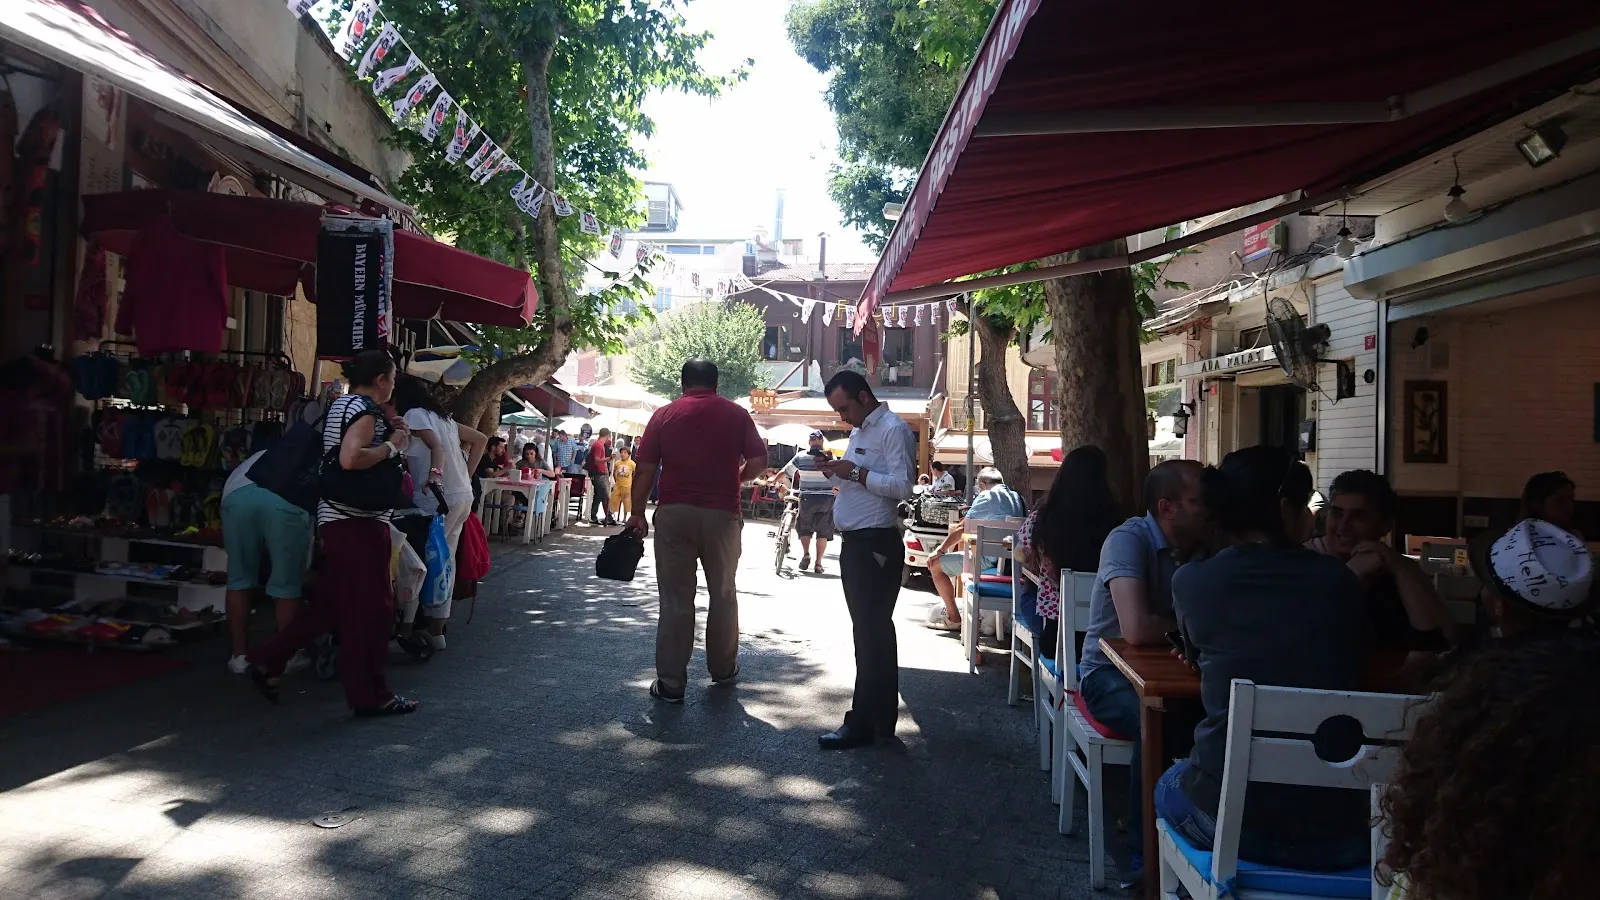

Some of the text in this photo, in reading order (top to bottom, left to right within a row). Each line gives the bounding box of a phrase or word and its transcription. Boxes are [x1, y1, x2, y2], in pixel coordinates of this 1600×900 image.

[352, 243, 368, 351] BAYERN MÜNCHEN
[1201, 350, 1262, 373] ADA PALAS
[1518, 551, 1549, 597] Hello
